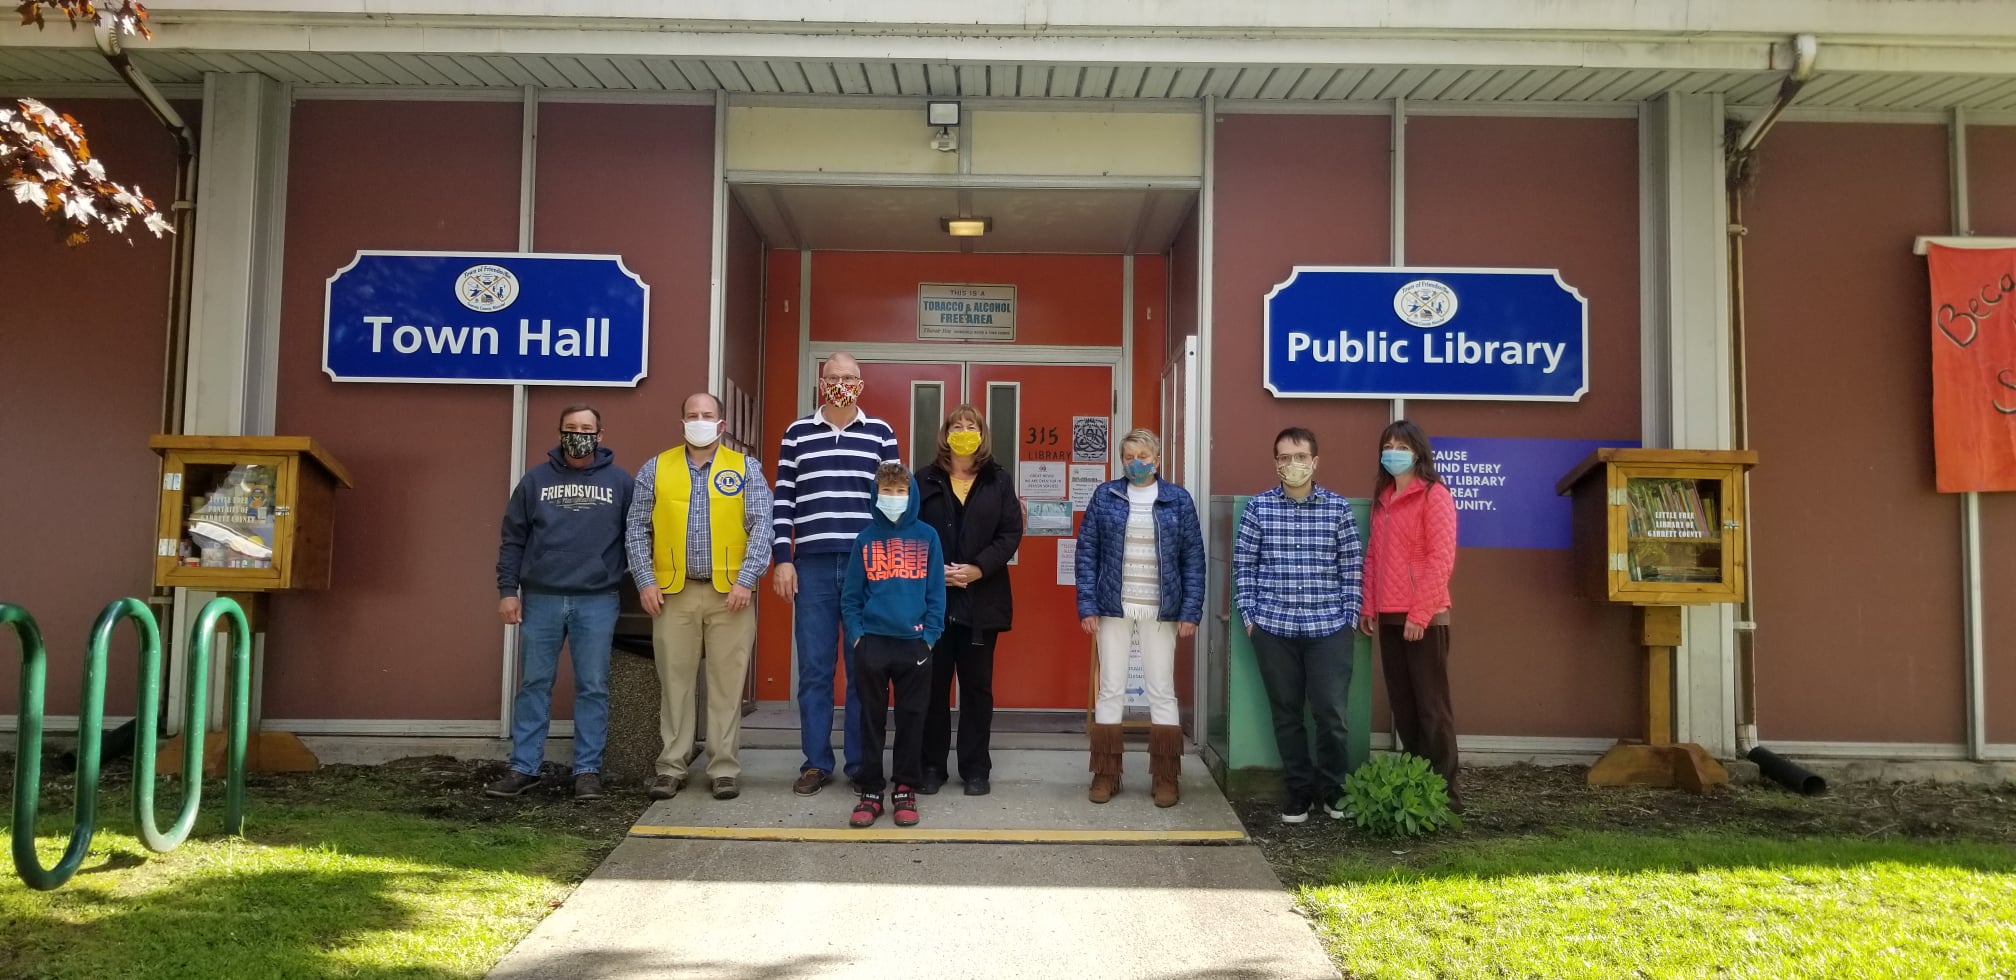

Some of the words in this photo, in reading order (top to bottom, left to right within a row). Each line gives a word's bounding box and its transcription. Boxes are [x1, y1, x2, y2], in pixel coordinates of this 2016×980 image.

[923, 300, 964, 312] TOBACCO
[973, 302, 1011, 313] ALCOHOL
[940, 313, 964, 324] FREE
[966, 314, 993, 325] AREA
[363, 316, 499, 355] Town
[518, 318, 610, 357] Hall
[1288, 331, 1409, 363] Public
[1423, 332, 1566, 374] Library
[1025, 427, 1059, 445] 315
[1028, 451, 1072, 460] LIBRARY
[1463, 463, 1501, 474] EVERY
[726, 477, 732, 485] L
[1456, 475, 1506, 486] LIBRARY
[540, 484, 613, 504] FRIENDSVILLE
[1655, 511, 1677, 519] LITTLE
[1656, 520, 1683, 528] LIBRARY
[1678, 530, 1701, 538] COUNTY
